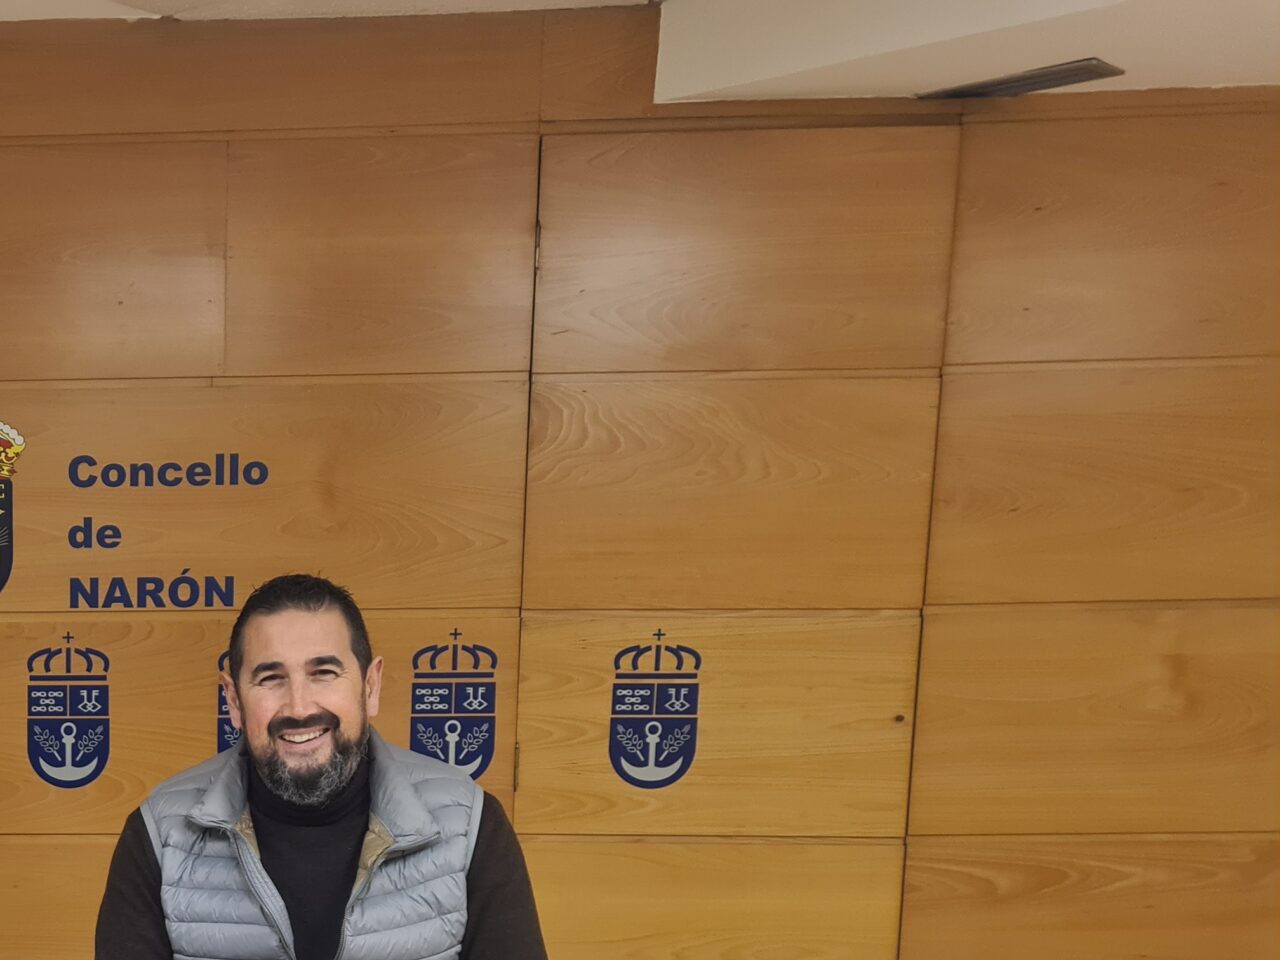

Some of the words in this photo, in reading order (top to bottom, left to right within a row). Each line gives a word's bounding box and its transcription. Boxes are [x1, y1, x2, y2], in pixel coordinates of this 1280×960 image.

[68, 453, 269, 488] Concello
[68, 517, 122, 549] de
[69, 568, 235, 609] NARÓN
